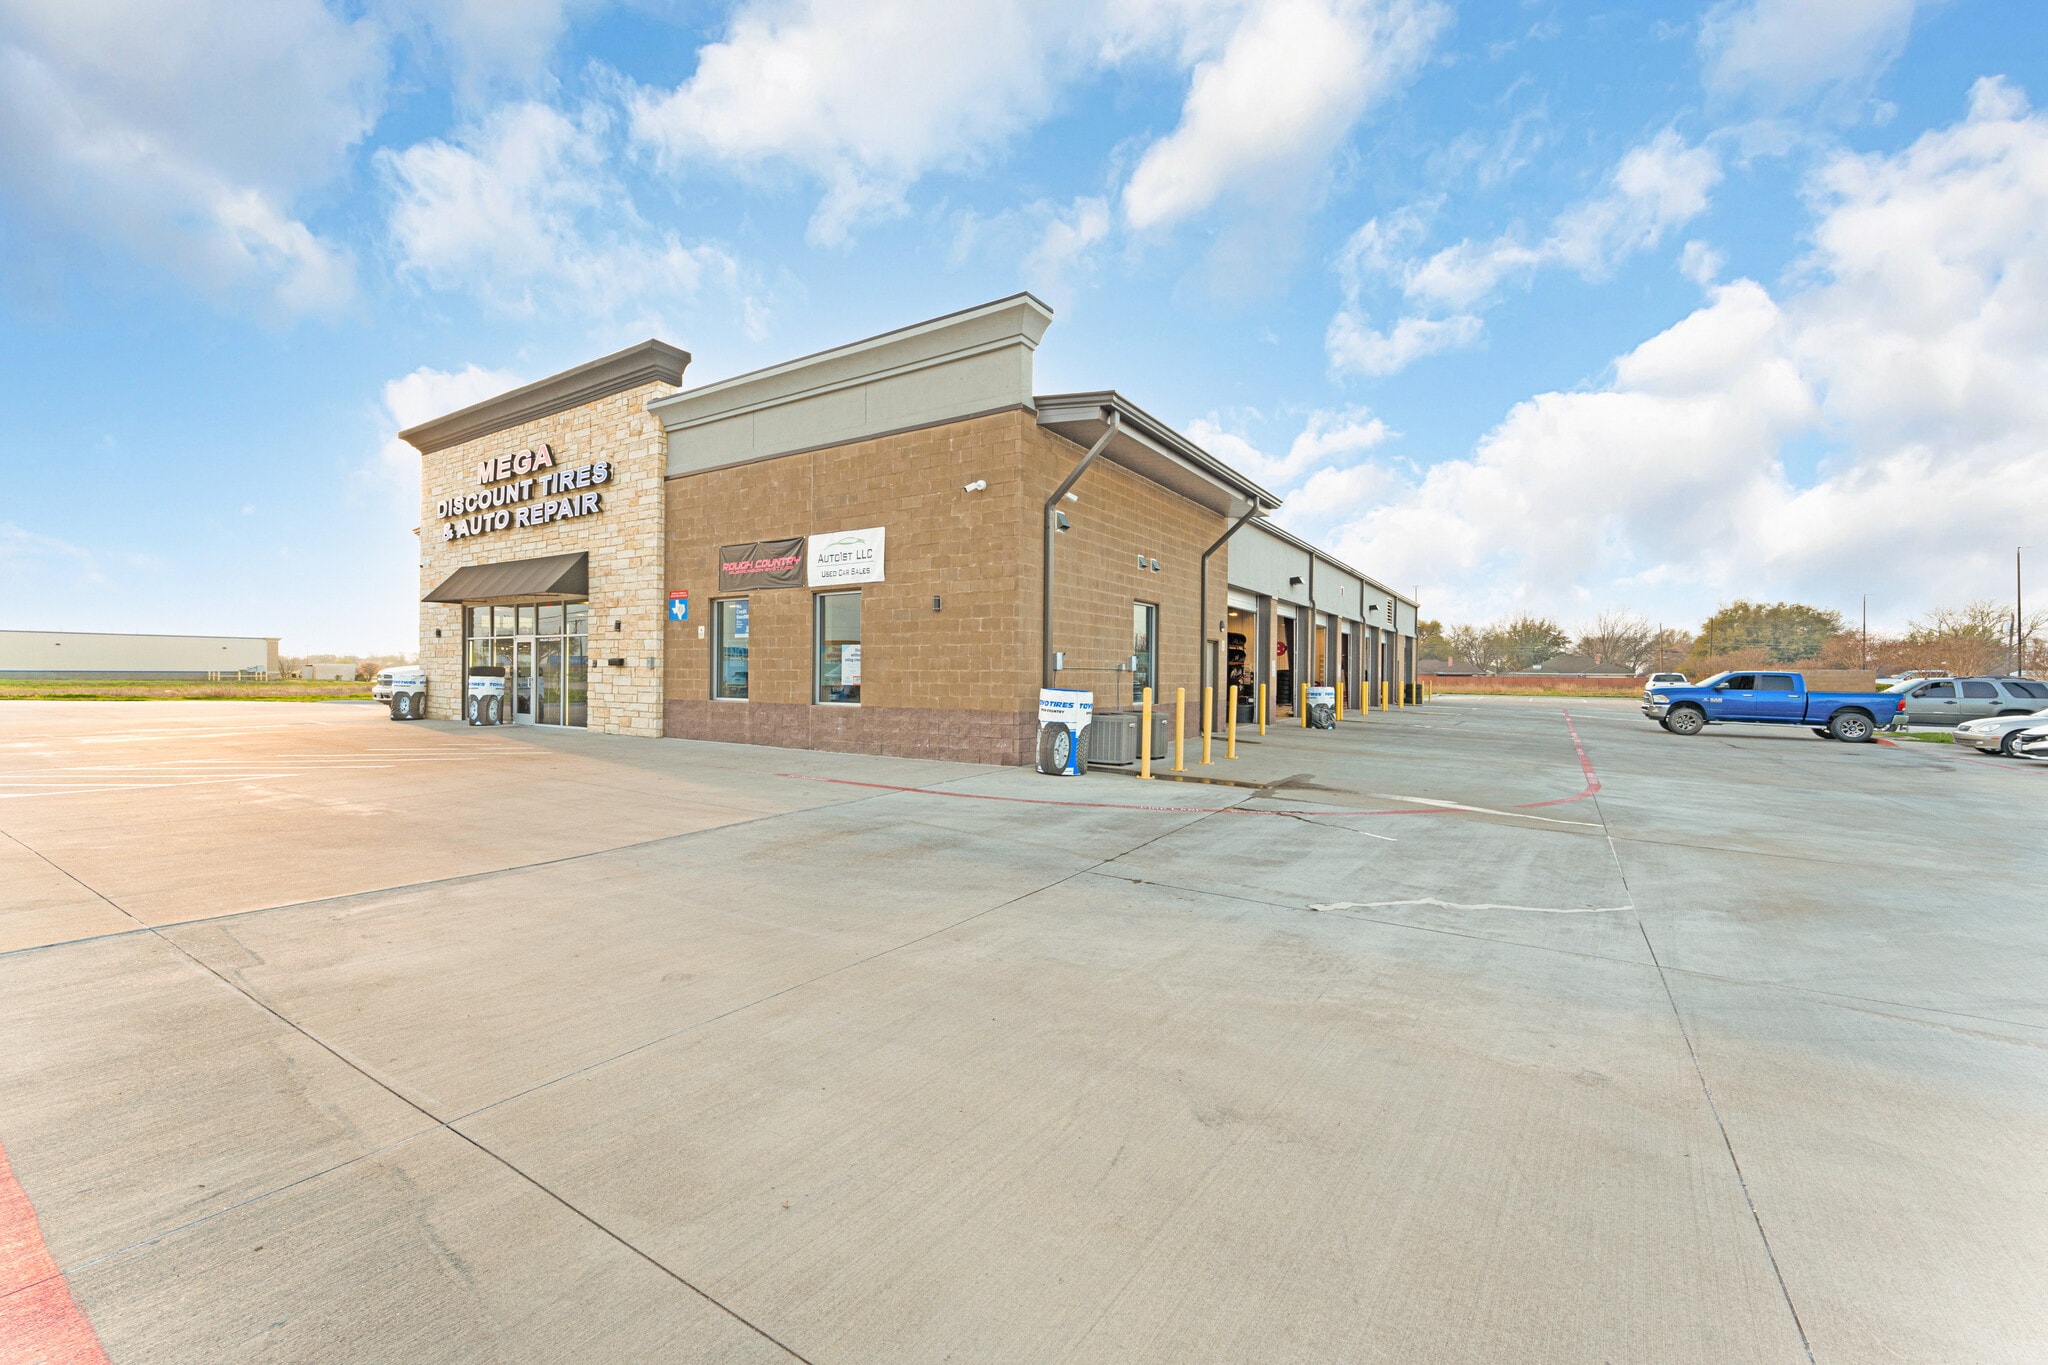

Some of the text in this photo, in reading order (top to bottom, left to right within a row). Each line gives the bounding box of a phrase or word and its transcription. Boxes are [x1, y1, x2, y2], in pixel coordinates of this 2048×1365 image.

[476, 443, 554, 486] MEGA
[436, 460, 609, 519] DISCOUNT TIRES
[441, 491, 600, 541] & AUTO REPAIR
[856, 548, 873, 560] LLC
[722, 555, 802, 572] ROUGH COUNTRY
[821, 567, 871, 578] USED CAR SALES
[1050, 701, 1074, 709] TIRES
